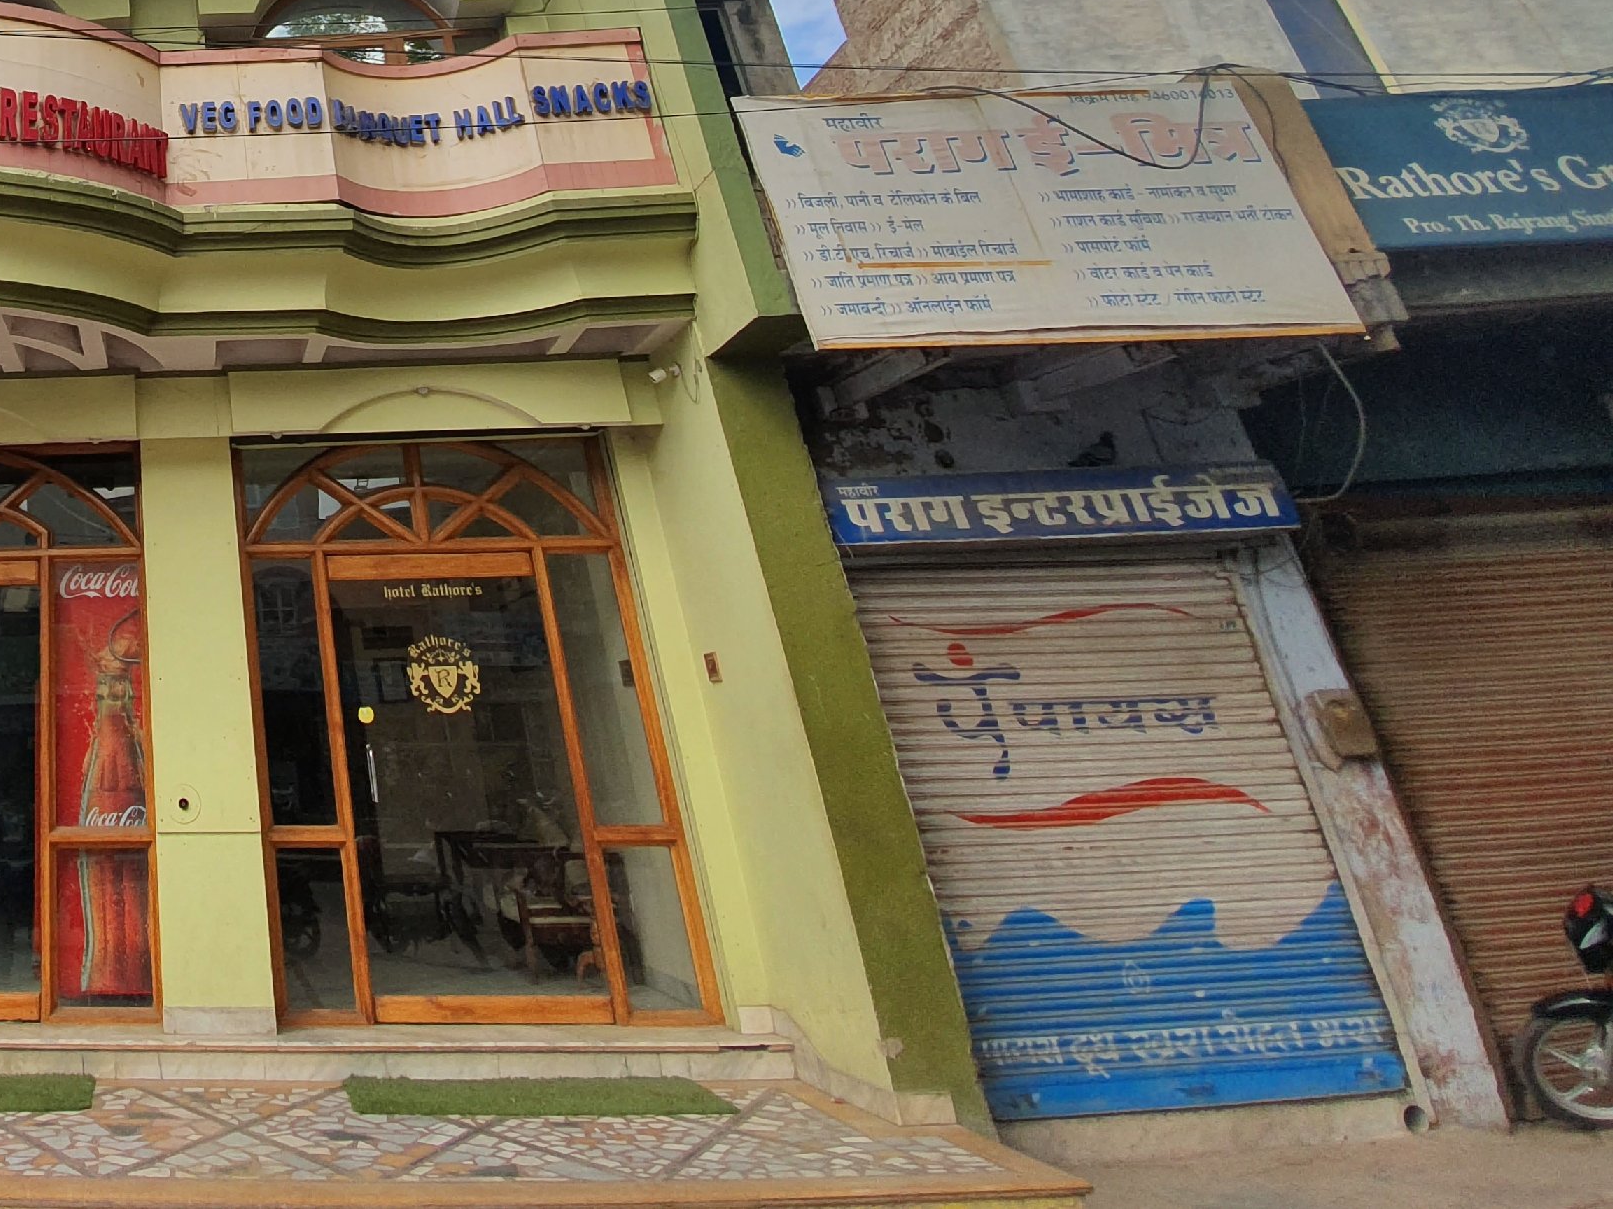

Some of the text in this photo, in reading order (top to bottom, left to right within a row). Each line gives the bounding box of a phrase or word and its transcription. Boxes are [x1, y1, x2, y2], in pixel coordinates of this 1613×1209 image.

[179, 100, 237, 134] VEG
[247, 96, 324, 132] FOOD
[453, 96, 525, 141] HALL
[533, 80, 652, 118] SNACKS
[823, 113, 884, 132] महावीर
[830, 130, 1017, 175] पराग
[1334, 159, 1561, 199] Rathore's
[807, 221, 829, 239] मूल
[825, 272, 854, 287] जाति
[933, 272, 958, 285] आय
[841, 496, 970, 533] पराग
[384, 584, 416, 600] hotel
